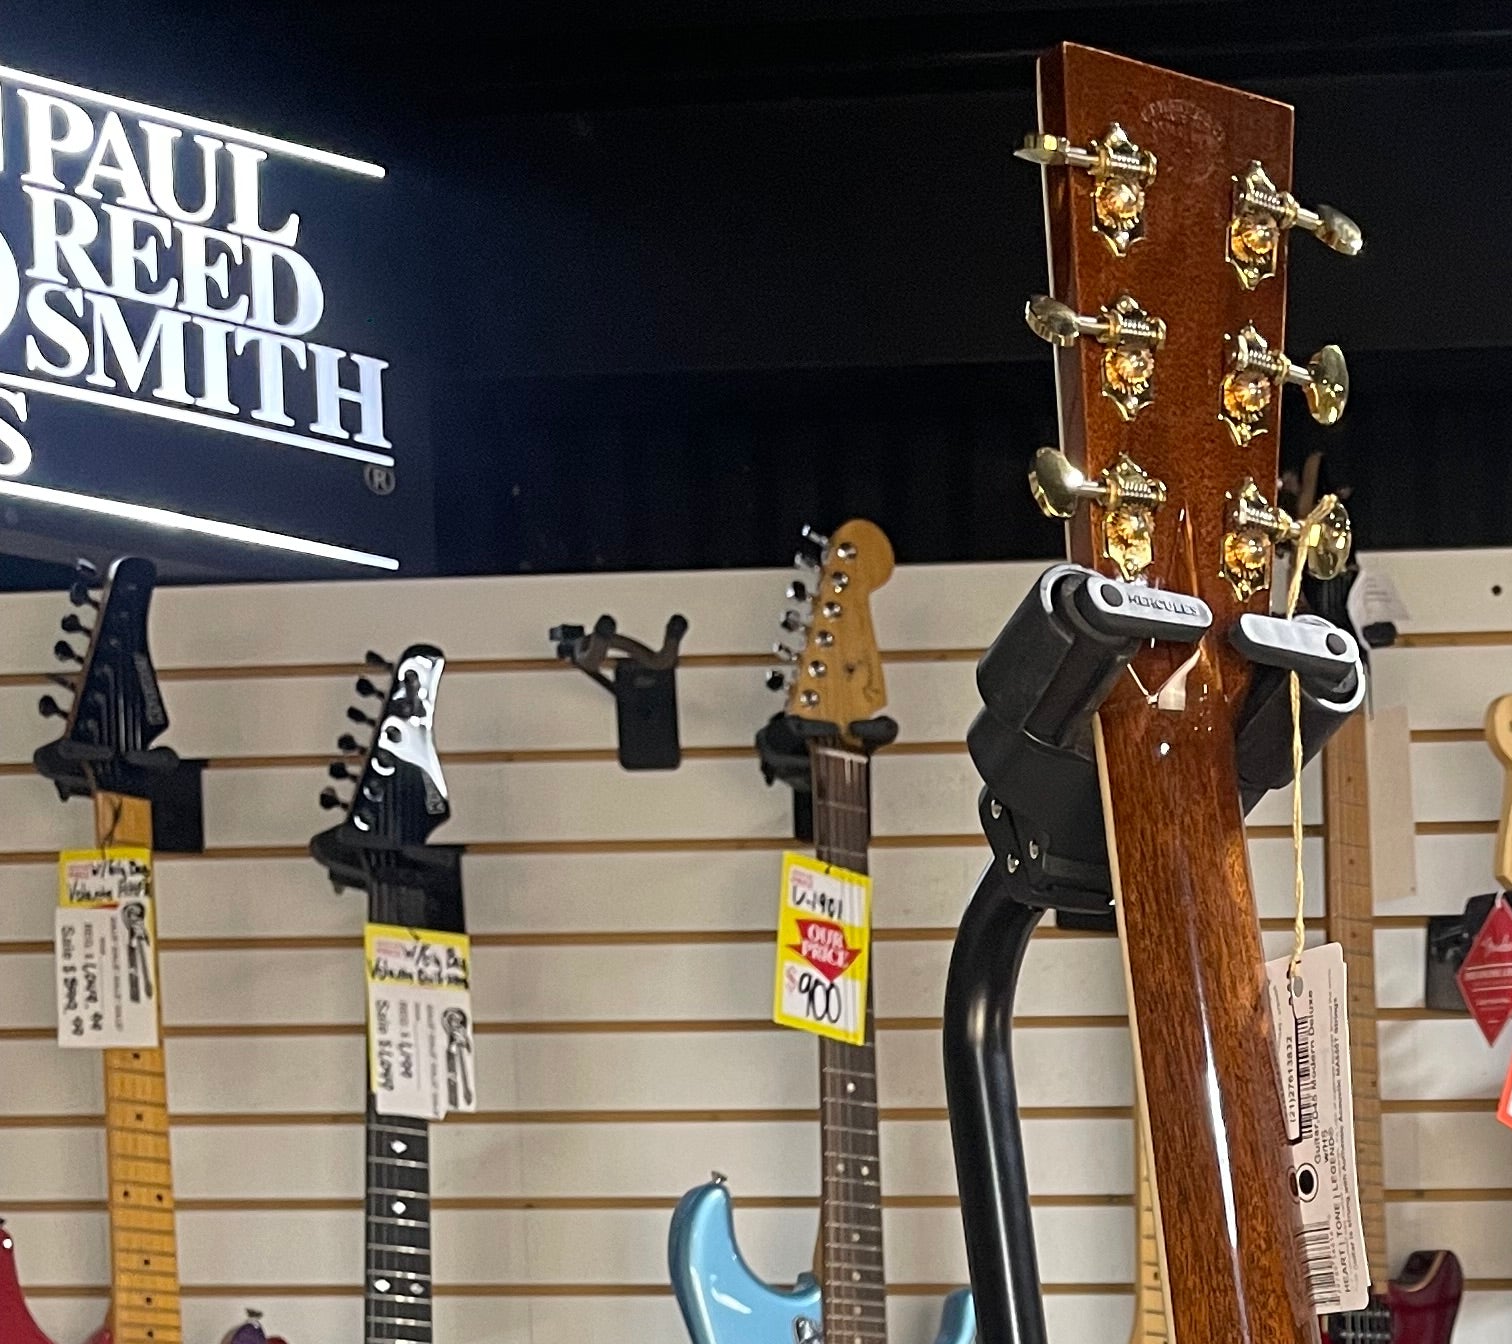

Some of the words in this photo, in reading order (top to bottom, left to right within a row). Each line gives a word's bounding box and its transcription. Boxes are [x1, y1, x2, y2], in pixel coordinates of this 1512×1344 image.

[17, 88, 300, 247] PAUL
[22, 183, 325, 337] REED
[25, 280, 393, 449] SMITH
[1127, 594, 1198, 617] HERCULES
[801, 939, 851, 969] PRICE
[806, 923, 845, 948] OUR
[1308, 989, 1316, 1036] Deluxe
[1308, 1040, 1318, 1091] Modern
[1333, 1202, 1343, 1238] TONE
[1339, 1250, 1351, 1293] HEART
